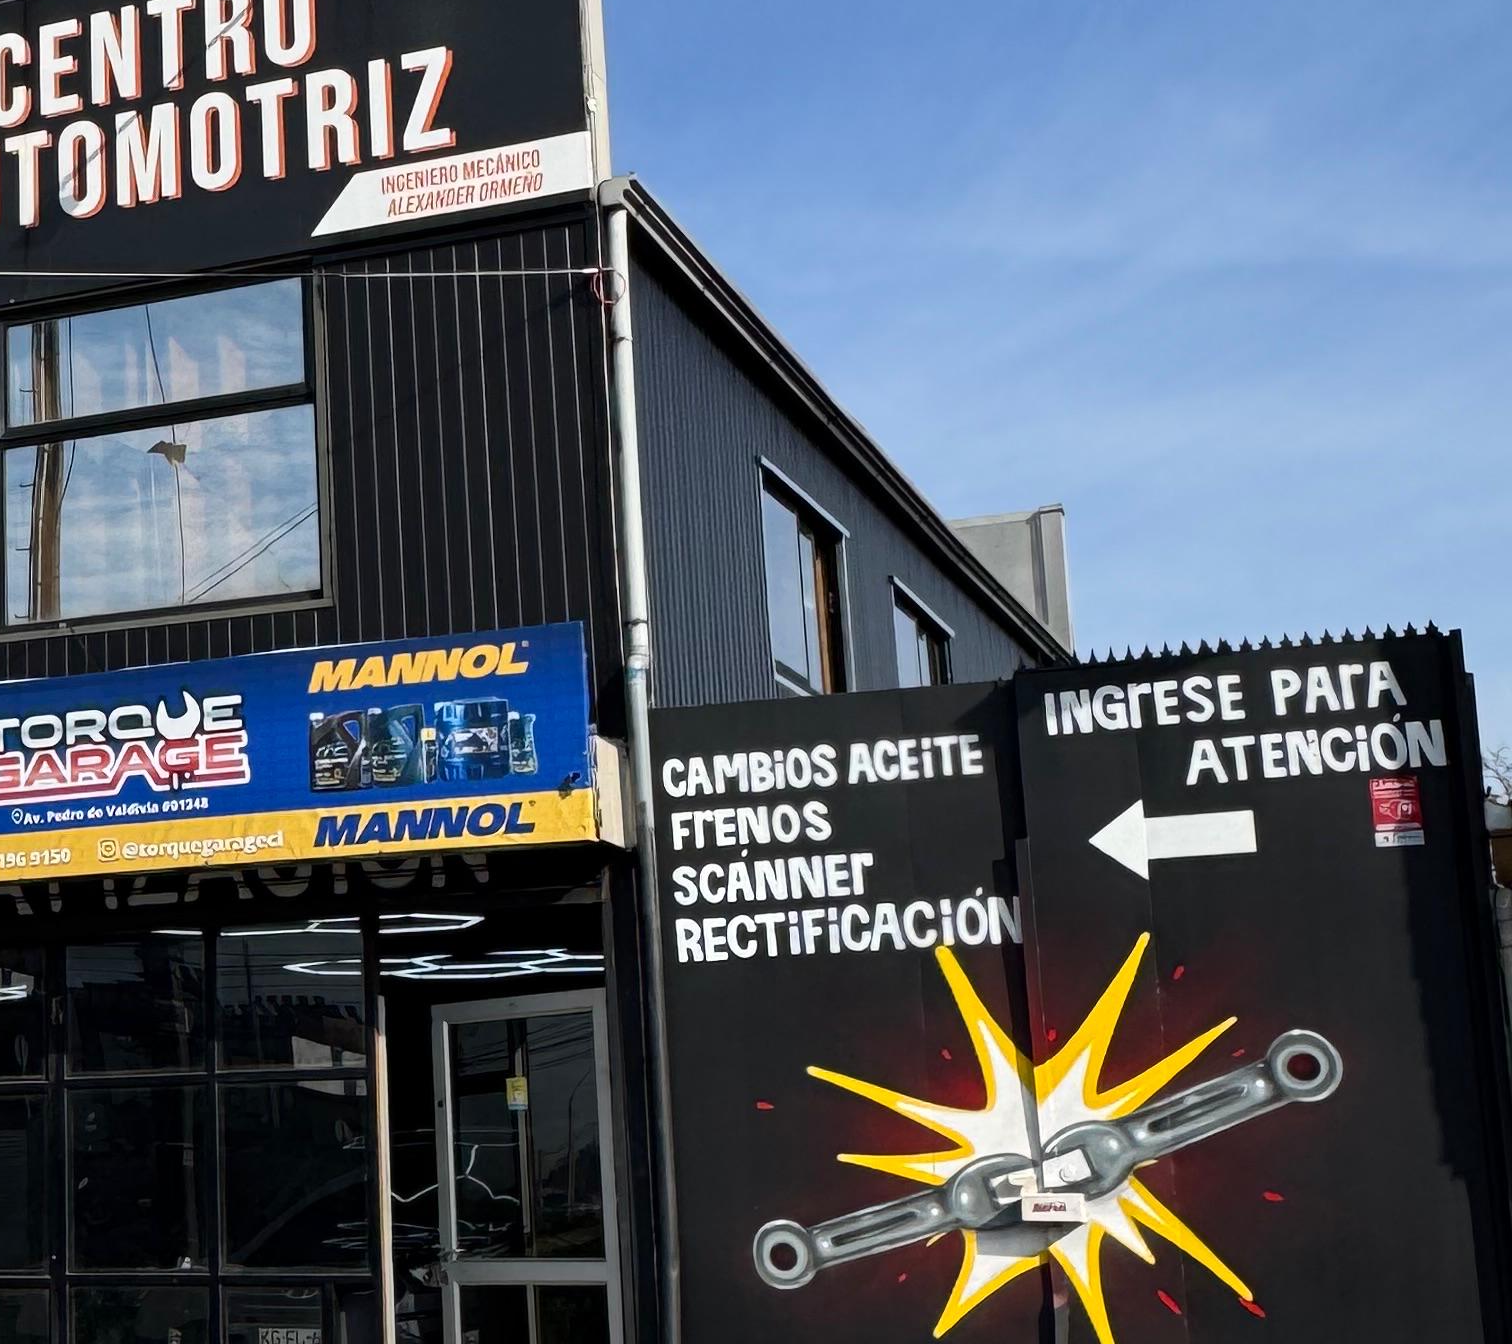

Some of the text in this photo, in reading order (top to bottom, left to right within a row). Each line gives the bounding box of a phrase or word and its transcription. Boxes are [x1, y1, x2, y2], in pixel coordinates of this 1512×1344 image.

[381, 148, 541, 195] INGENIERO MECÁNICO
[388, 172, 544, 218] ALEXANDER ORMEÑO
[308, 643, 529, 694] MANNOL
[23, 812, 45, 826] Av.
[47, 808, 85, 823] Pedro
[106, 800, 159, 817] Valdivia
[313, 801, 535, 848] MANNOL
[29, 847, 72, 867] 9150
